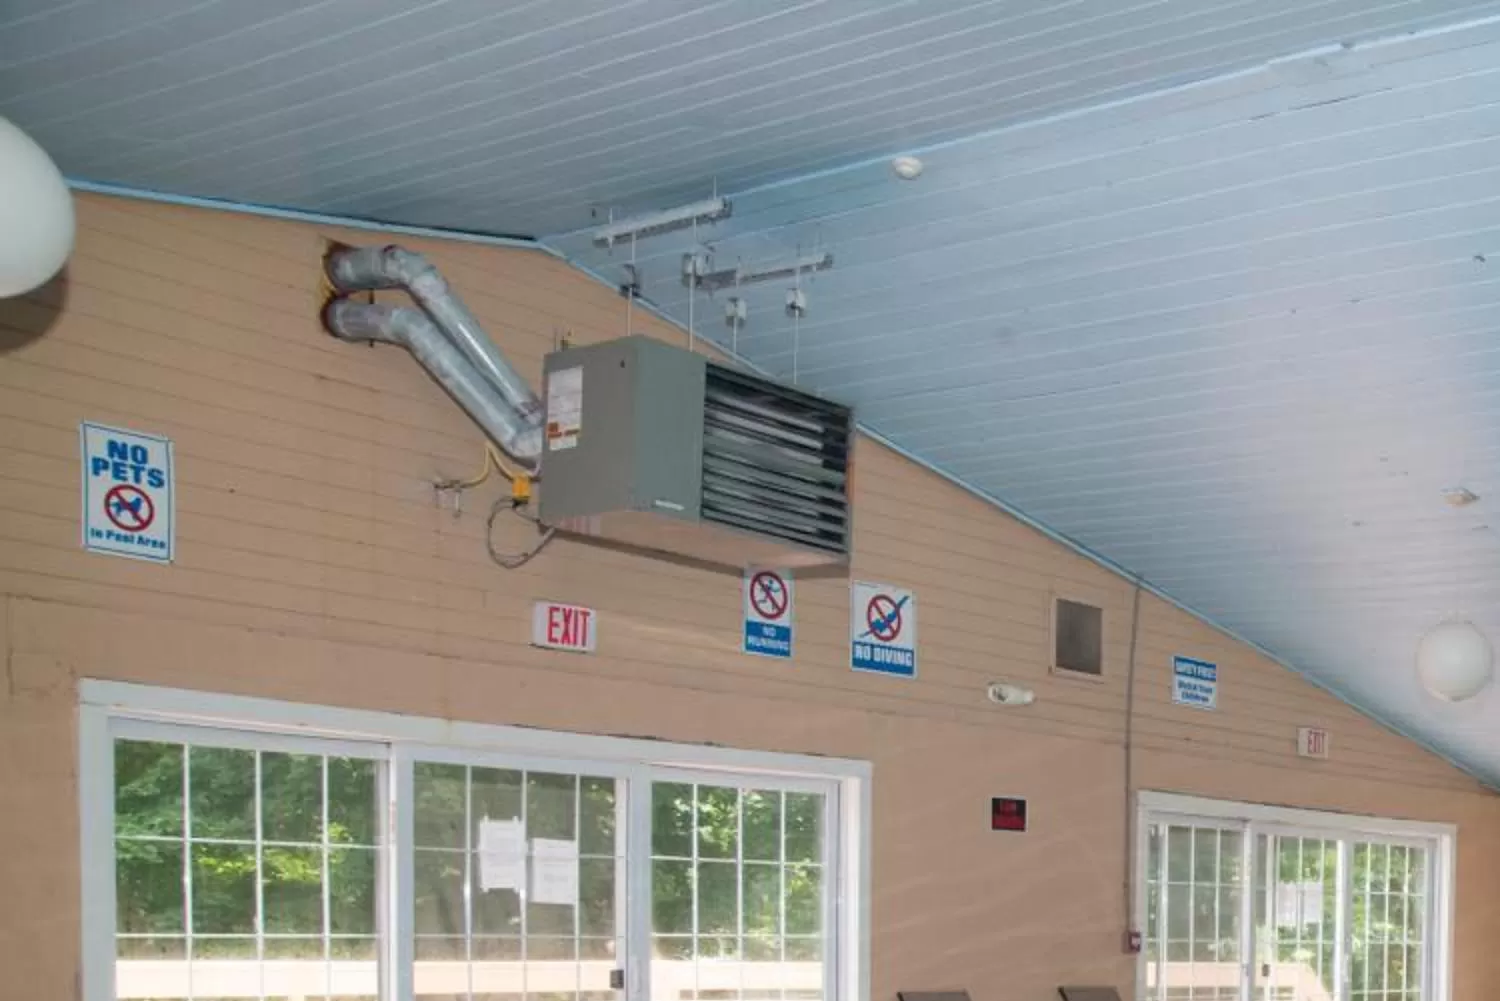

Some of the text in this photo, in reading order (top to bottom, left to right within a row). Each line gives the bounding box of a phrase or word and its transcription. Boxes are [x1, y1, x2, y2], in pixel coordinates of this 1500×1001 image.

[107, 439, 149, 465] NO
[91, 455, 165, 489] PETS
[105, 529, 135, 543] Pool
[136, 535, 167, 549] Area
[547, 605, 591, 648] EXIT
[854, 644, 913, 666] NO DIVING
[1307, 730, 1326, 753] EXIT
